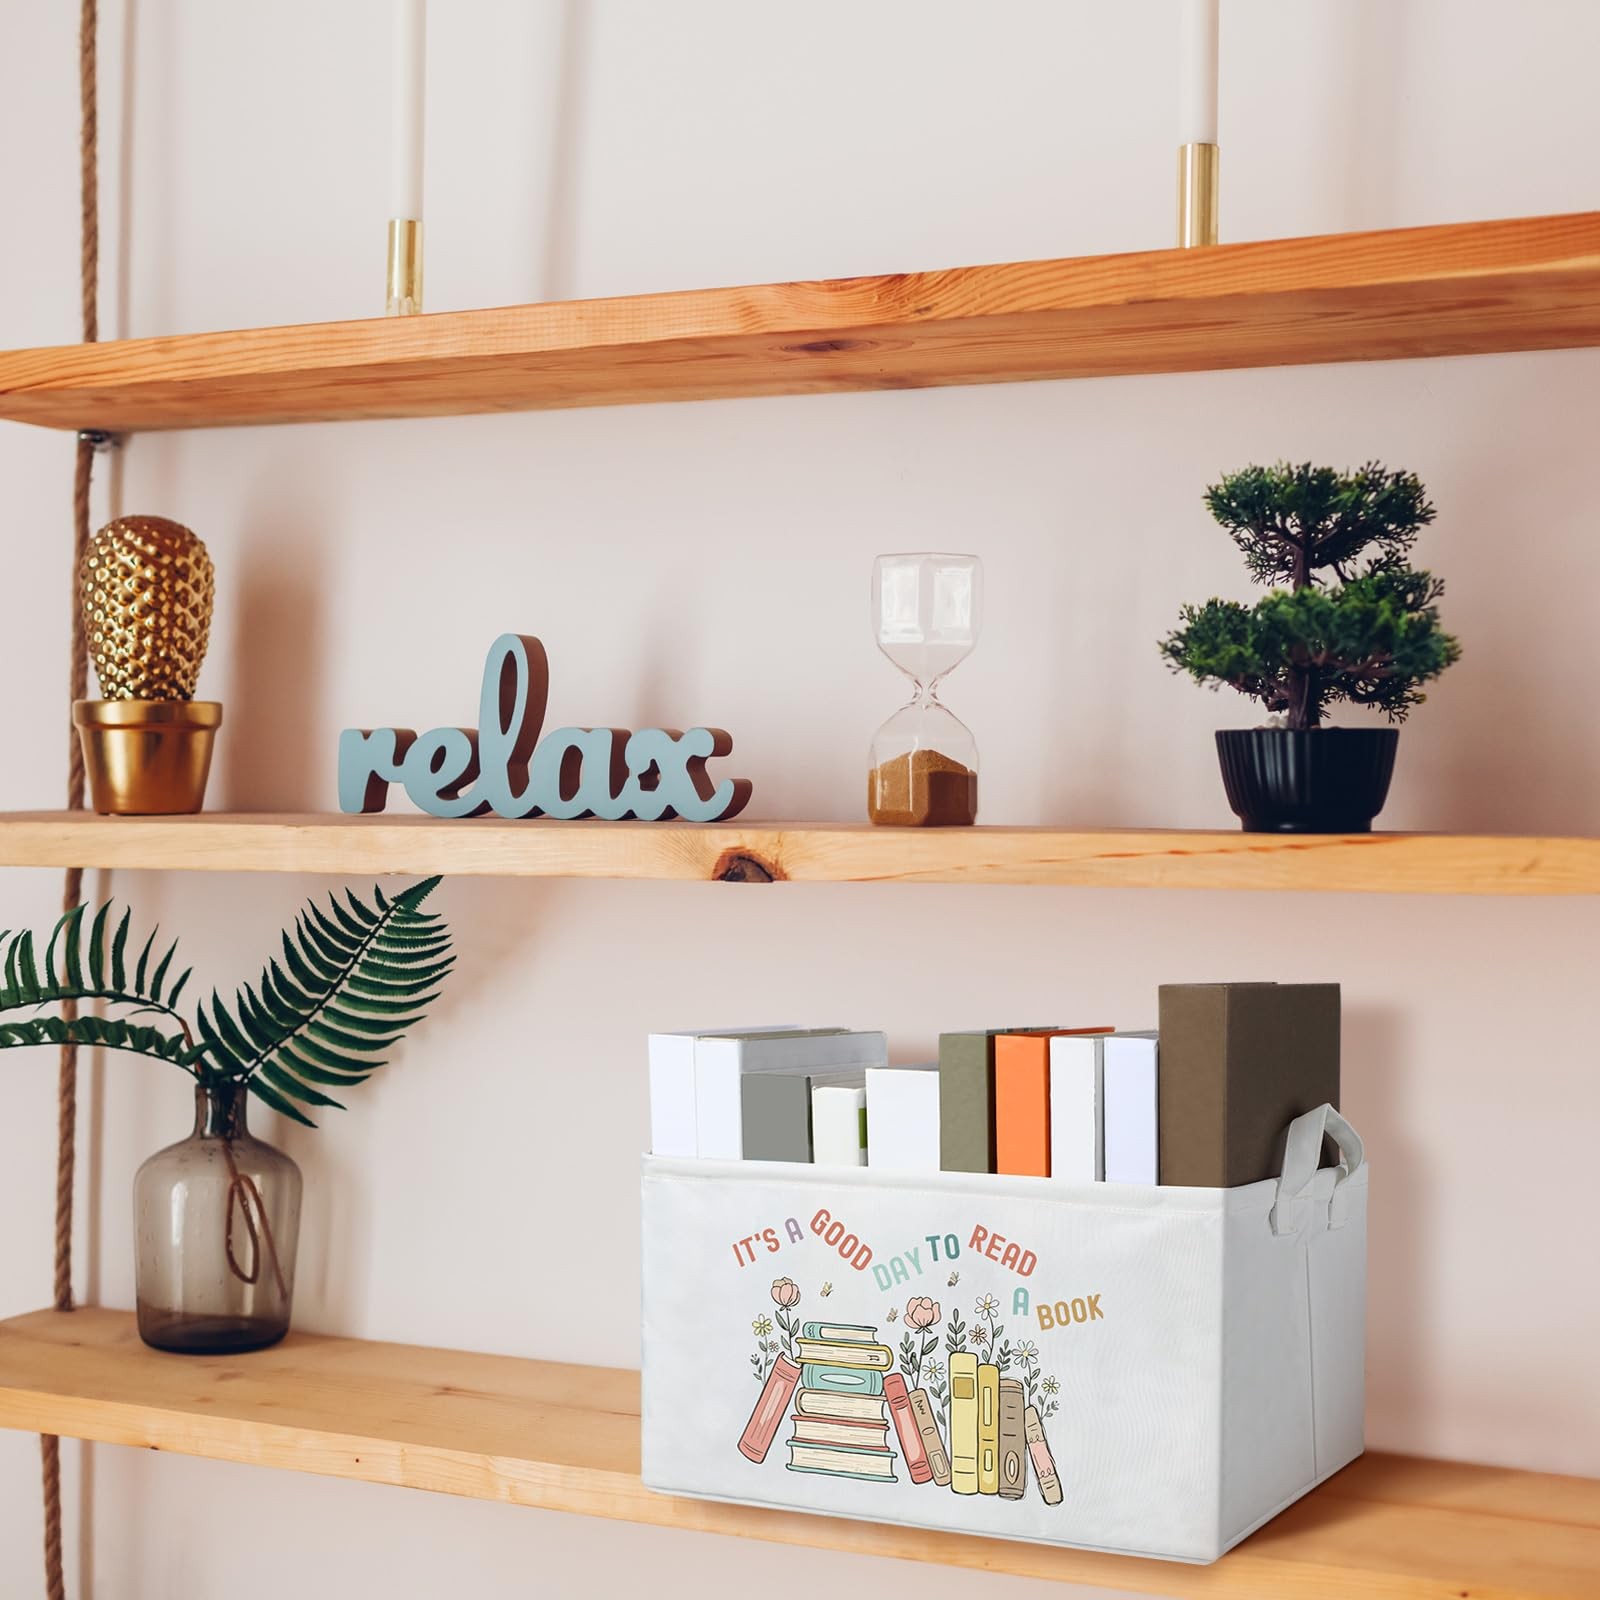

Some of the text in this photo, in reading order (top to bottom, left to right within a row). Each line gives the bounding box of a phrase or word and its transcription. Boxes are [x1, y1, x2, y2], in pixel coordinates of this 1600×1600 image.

[338, 633, 753, 822] relax
[732, 1208, 1038, 1292] IT'S A GOOD DAY TO READ
[1012, 1287, 1104, 1331] A BOOK
